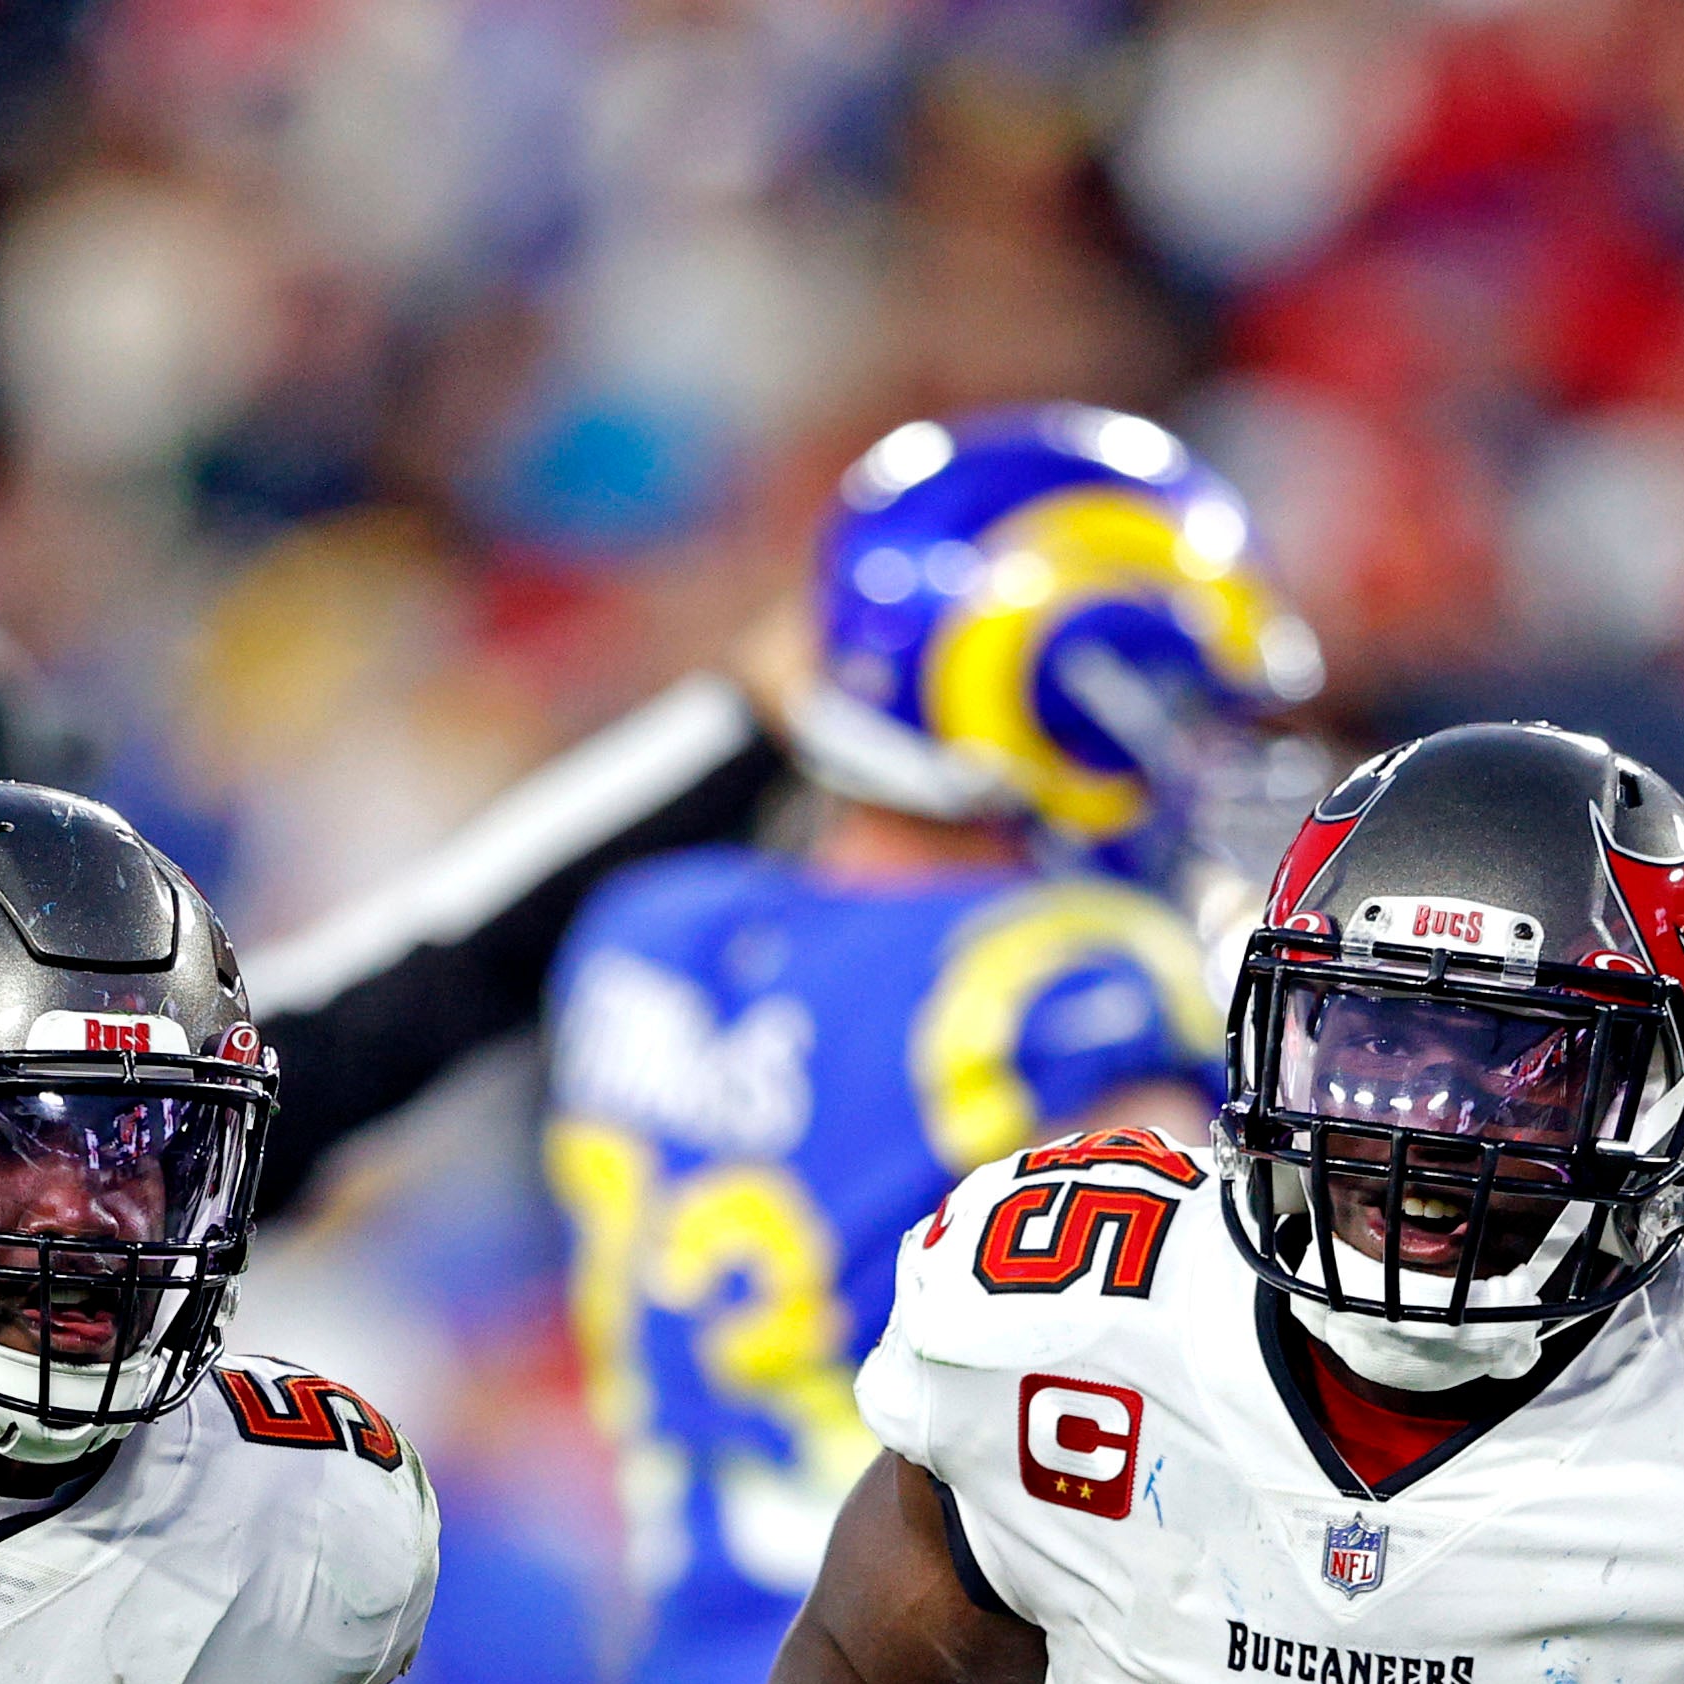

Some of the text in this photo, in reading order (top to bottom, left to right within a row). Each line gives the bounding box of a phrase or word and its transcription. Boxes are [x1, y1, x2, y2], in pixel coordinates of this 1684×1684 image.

[971, 1127, 1210, 1300] 45
[1027, 1386, 1132, 1483] C
[1330, 1550, 1374, 1584] NFL
